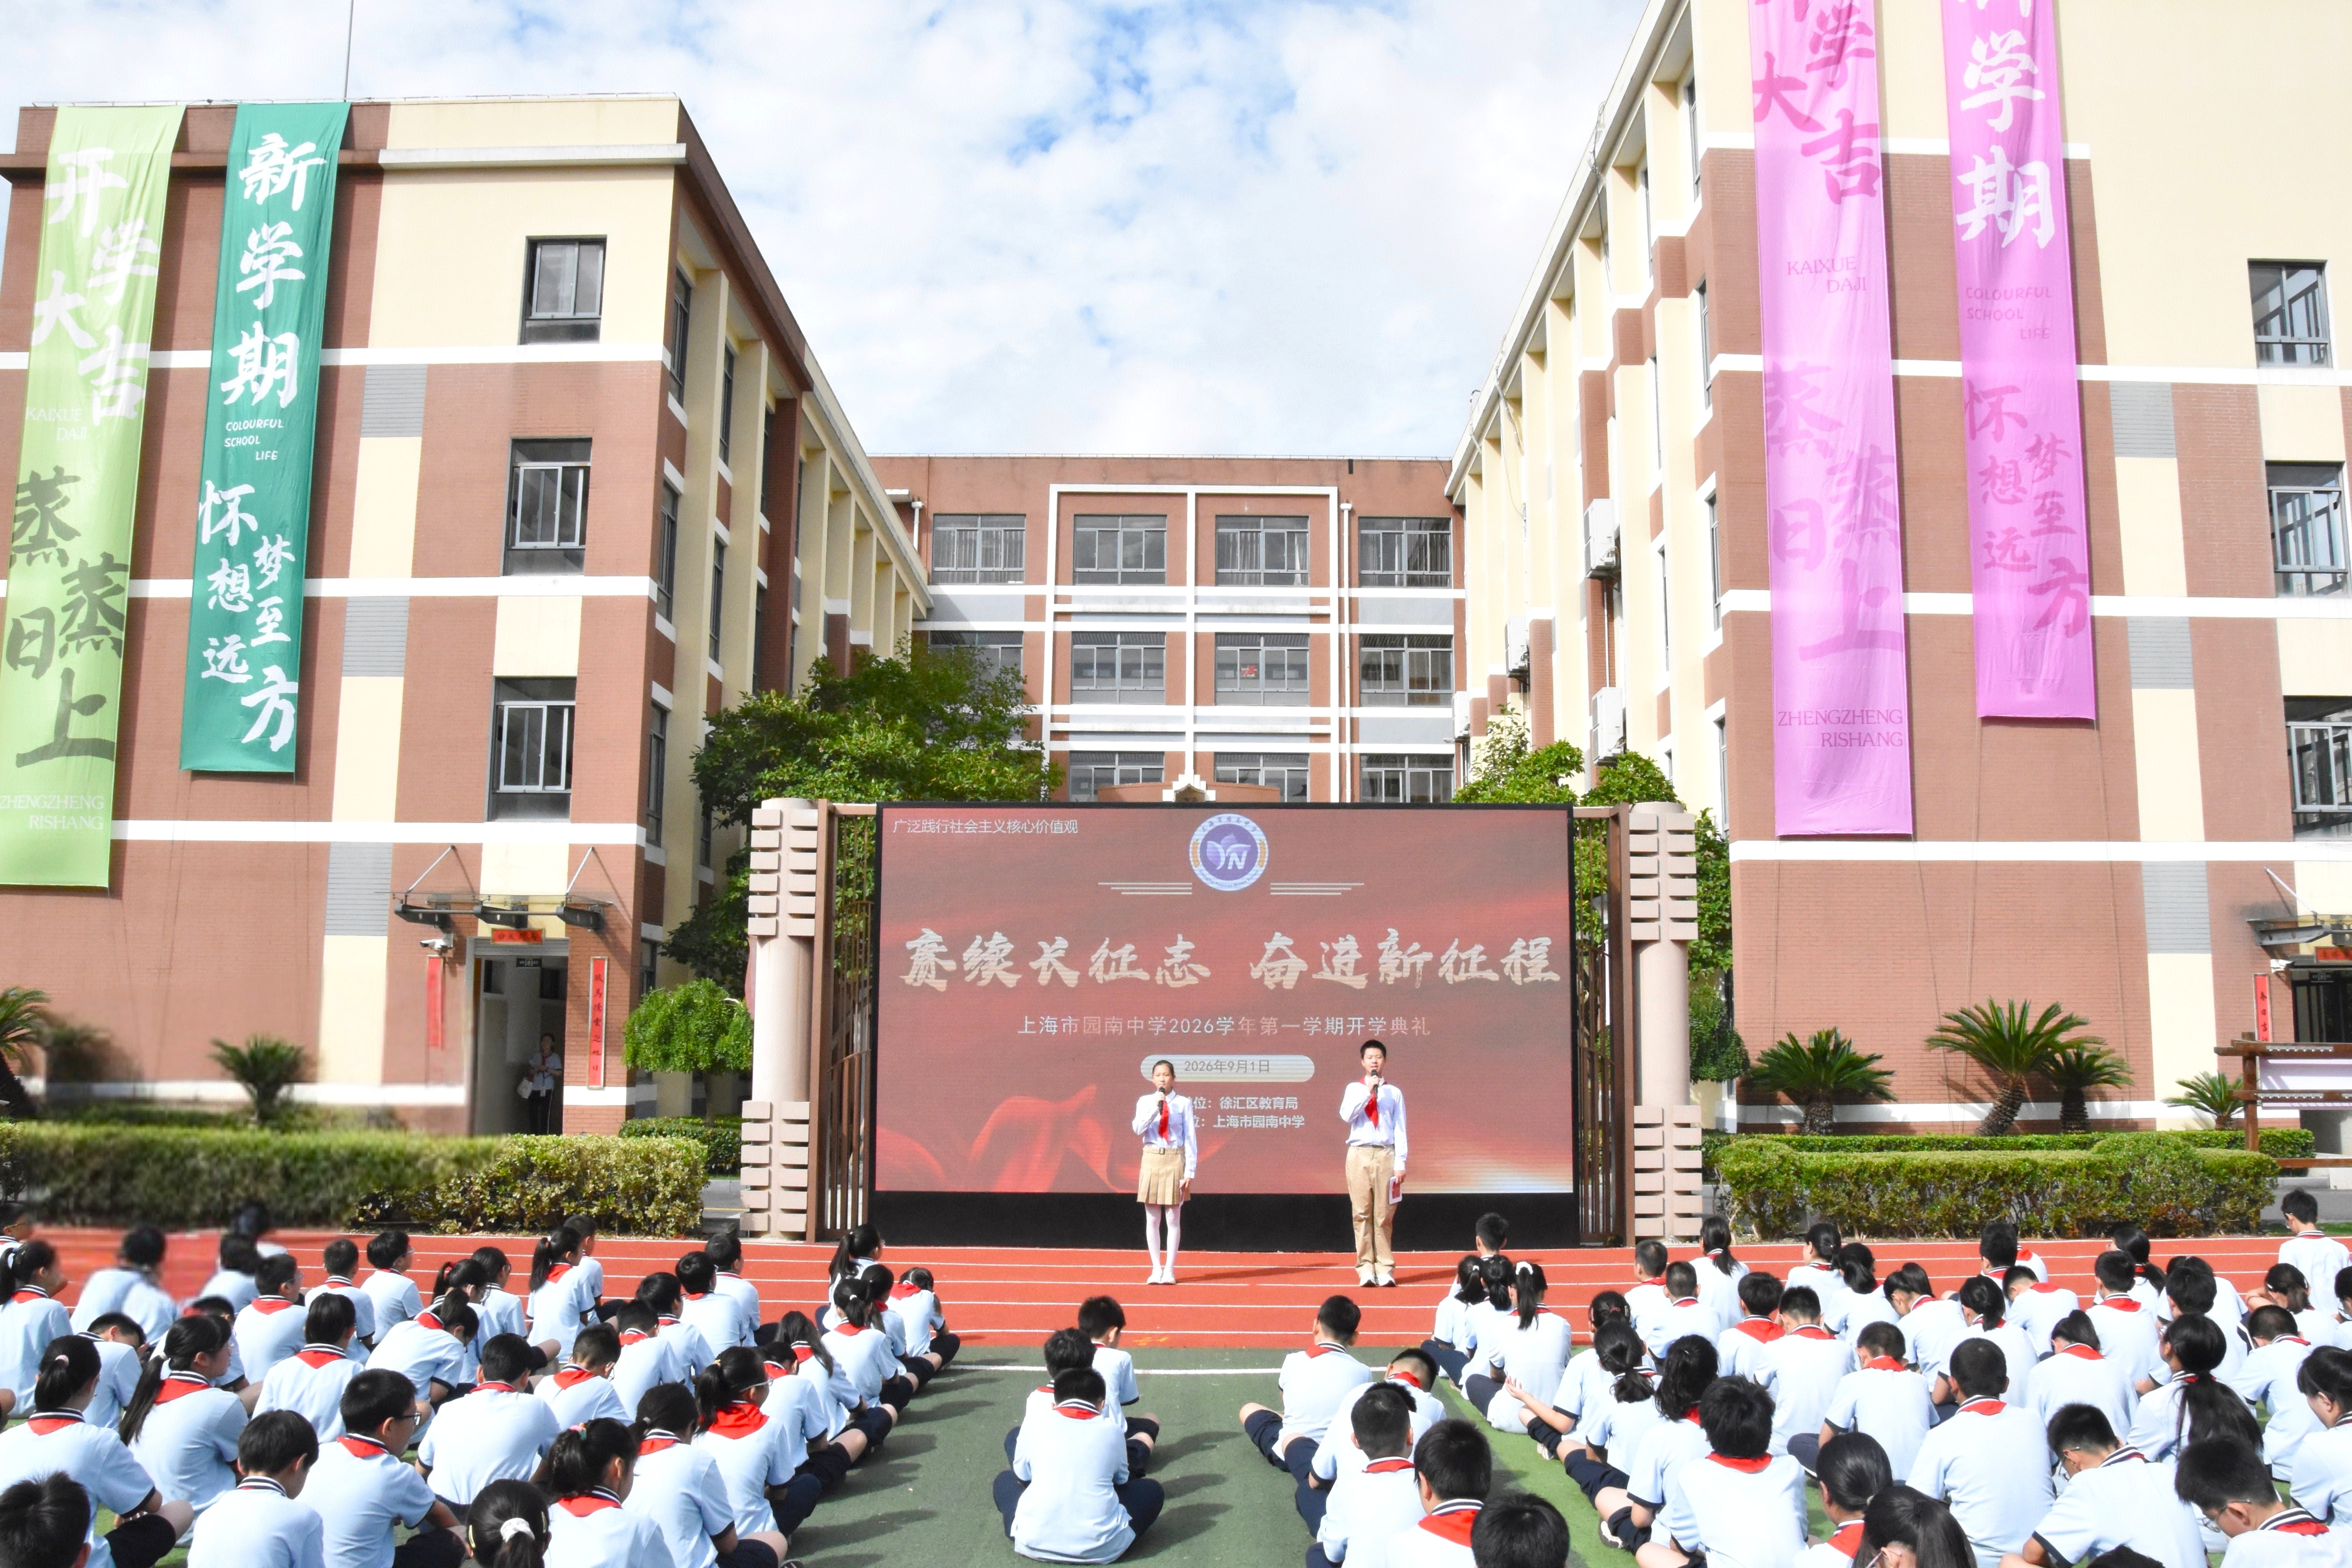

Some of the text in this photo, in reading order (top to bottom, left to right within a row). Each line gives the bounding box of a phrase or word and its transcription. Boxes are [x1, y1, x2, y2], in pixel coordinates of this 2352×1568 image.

[1753, 0, 1880, 204] 学大吉
[1956, 0, 2054, 249] 学期
[220, 133, 327, 408] 新学期
[1787, 257, 1856, 275] KAIXUE
[31, 147, 161, 426] 开学大吉
[1827, 277, 1867, 293] DAJI
[1966, 287, 2052, 300] COLOURFUL
[1967, 308, 2023, 320] SCHOOL
[2021, 328, 2049, 339] LIFE
[25, 407, 83, 421] KAIXUE
[226, 419, 283, 431] COLOURFUL
[56, 427, 87, 440] DAJI
[224, 435, 260, 447] SCHOOL
[256, 451, 278, 460] LIFE
[1778, 709, 1903, 726] ZHENGZHENG
[1821, 731, 1903, 747] RISHANG
[0, 795, 104, 809] ZHENGZHENG
[29, 815, 103, 829] RISHANG
[893, 819, 1078, 834] 广泛践行社会主义核心价值观
[1250, 928, 1560, 989] 奋进新征程
[1018, 1016, 1430, 1035] 上海市园南中学2026学年第一学期开学典礼
[1184, 1060, 1269, 1073] 2026年9月1日
